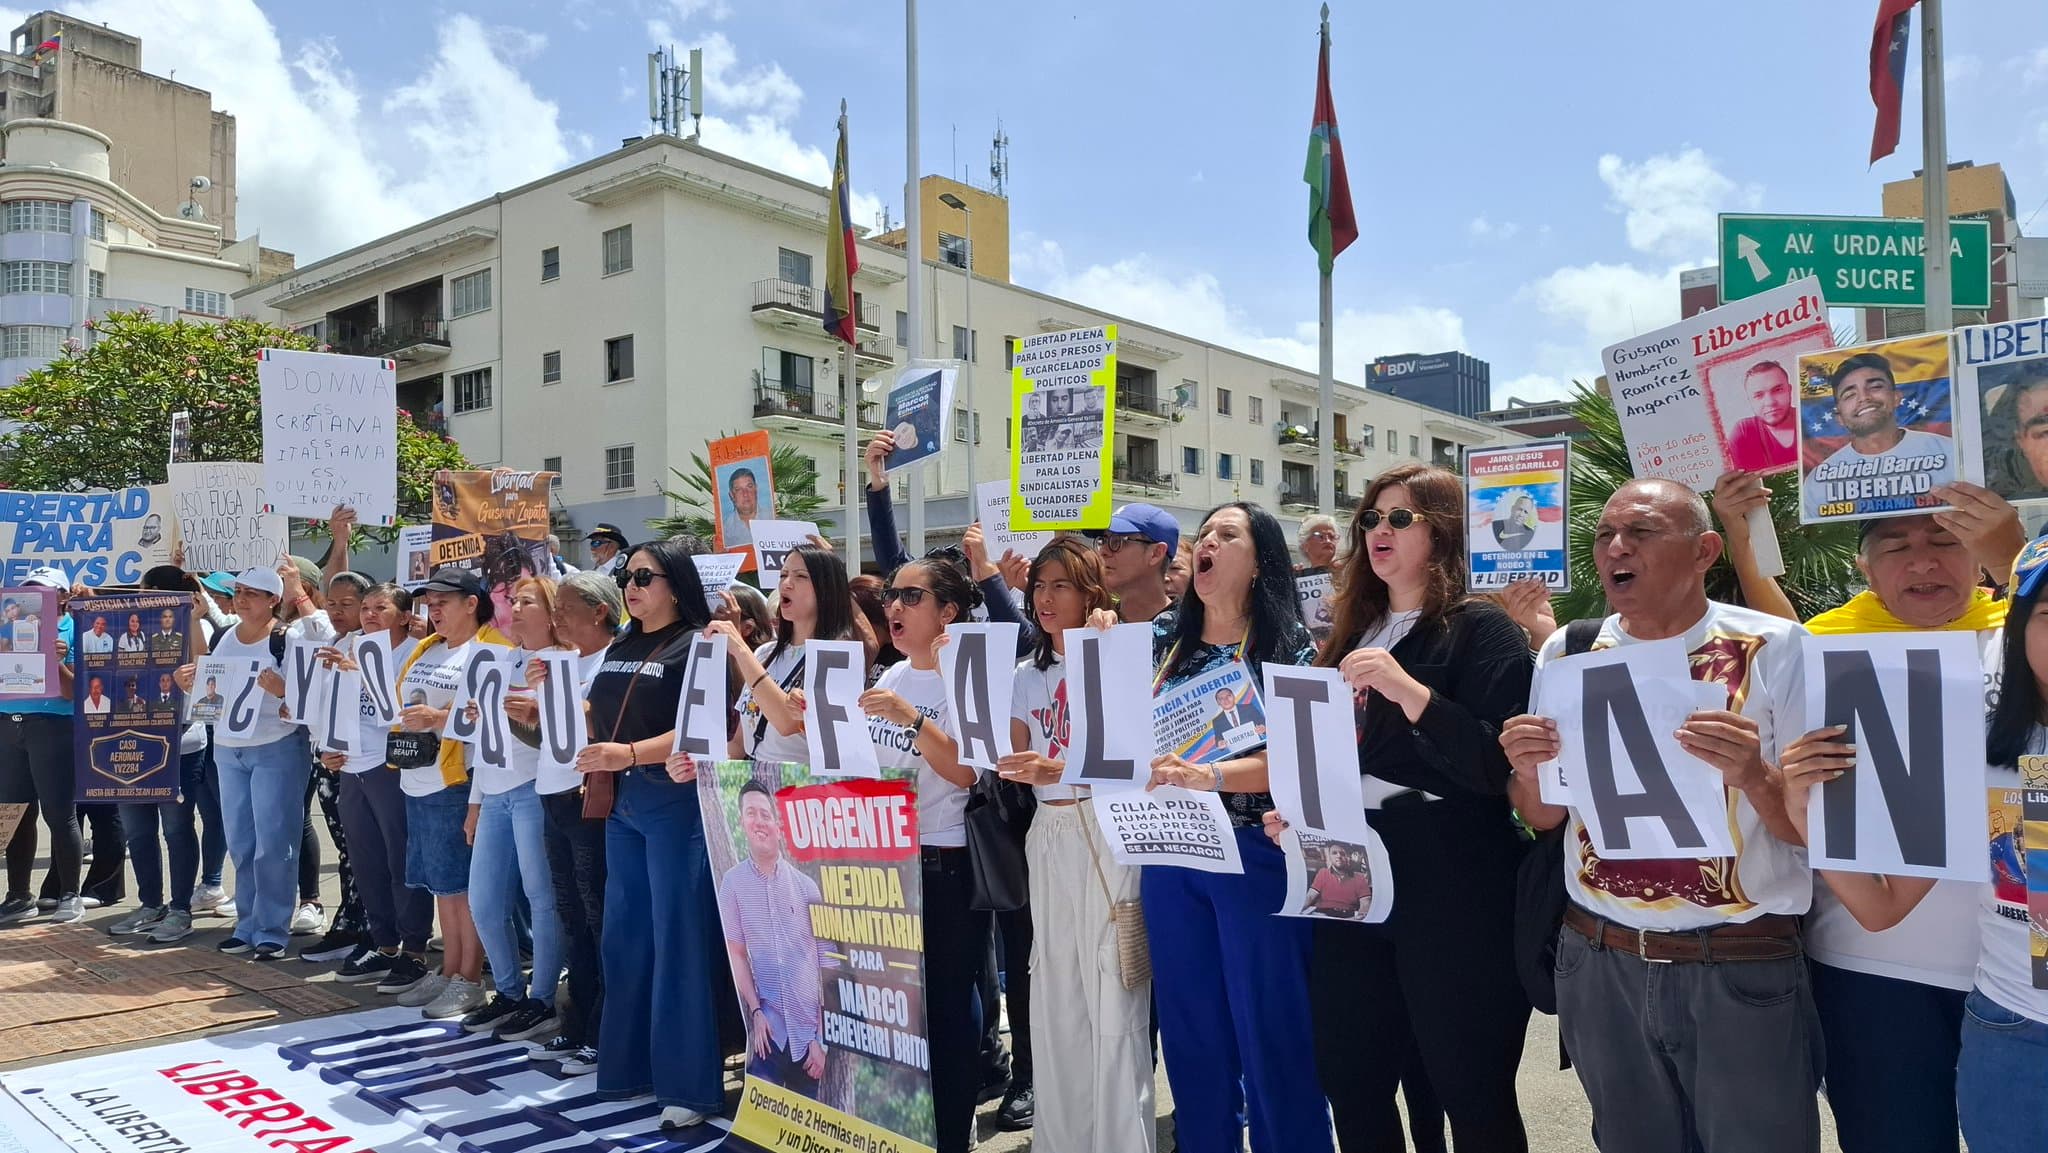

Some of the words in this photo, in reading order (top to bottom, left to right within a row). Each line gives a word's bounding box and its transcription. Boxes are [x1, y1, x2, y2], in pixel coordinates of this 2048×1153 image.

[1784, 233, 1814, 255] AV.
[1834, 234, 1964, 258] URDANEA
[1836, 268, 1915, 290] SUCRE
[1691, 295, 1823, 357] Libertad!
[1024, 333, 1067, 348] LIBERTAD
[1070, 329, 1104, 341] PLENA
[1016, 353, 1037, 364] PARA
[1039, 349, 1057, 360] LOS
[1061, 344, 1102, 357] PRESOS
[1105, 342, 1112, 351] Y
[1613, 337, 1681, 365] Gusman
[1025, 358, 1101, 376] EXCARCELADOS
[1388, 360, 1416, 376] BDV
[283, 367, 390, 398] DONNA
[1037, 375, 1088, 388] POLÍTICOS
[1622, 368, 1692, 400] Ramírez
[1021, 453, 1064, 465] LIBERTAD
[1067, 450, 1099, 461] PLENA
[1488, 454, 1513, 464] JAIRO
[1036, 467, 1059, 477] PARA
[1062, 465, 1081, 475] LOS
[1474, 464, 1514, 474] VILLEGAS
[1515, 460, 1560, 471] CARRILLO
[1815, 457, 1880, 482] Gabriel
[1882, 453, 1946, 475] Barros
[1020, 479, 1089, 492] SINDICALISTAS
[1093, 478, 1099, 488] Y
[1826, 473, 1931, 502] LIBERTAD
[0, 487, 150, 524] IBERTAD
[209, 490, 243, 517] FUGA
[987, 496, 1010, 506] LIBERT
[1025, 494, 1088, 506] LUCHADORES
[1818, 502, 1855, 516] CASO
[1032, 508, 1078, 519] SOCIALES
[183, 519, 199, 544] EX
[250, 516, 263, 539] DE
[993, 522, 1007, 531] LOS
[11, 522, 114, 554] PARA
[758, 540, 777, 549] QUE
[439, 536, 481, 560] DETENIDA
[1482, 553, 1521, 561] DETENIDO
[1538, 551, 1549, 559] EL
[765, 554, 776, 567] A
[1497, 561, 1525, 569] RODEO
[83, 599, 123, 611] JUSTICIA
[134, 596, 181, 609] LIBERTAD
[1183, 692, 1190, 702] Y
[1191, 670, 1242, 699] LIBERTAD
[119, 739, 137, 750] CASO
[393, 749, 419, 757] BEAUTY
[395, 740, 418, 749] LITTLE
[110, 751, 145, 762] AERONAVE
[1110, 802, 1159, 813] CILIA
[1165, 800, 1210, 812] PIDE
[785, 795, 912, 849] URGENTE
[1131, 822, 1158, 831] LOS
[1163, 822, 1217, 832] PRESOS
[1120, 828, 1221, 845] POLÍTICOS
[1127, 845, 1143, 853] SE
[1144, 844, 1161, 853] LA
[1163, 844, 1224, 858] NEGARON
[820, 865, 905, 909] MEDIDA
[809, 904, 924, 952] HUMANITARIA
[849, 949, 885, 972] PARA
[838, 978, 909, 1028] MARCO
[823, 1010, 891, 1058] ECHEVERRI
[892, 1028, 929, 1072] BRITO
[70, 1088, 120, 1108] LA
[749, 1086, 790, 1118] Operado
[791, 1103, 804, 1124] de
[805, 1108, 812, 1128] 2
[813, 1112, 852, 1143] Hernias
[852, 1133, 867, 1149] en
[866, 1133, 878, 1153] la
[775, 1127, 787, 1146] y
[787, 1133, 801, 1150] un
